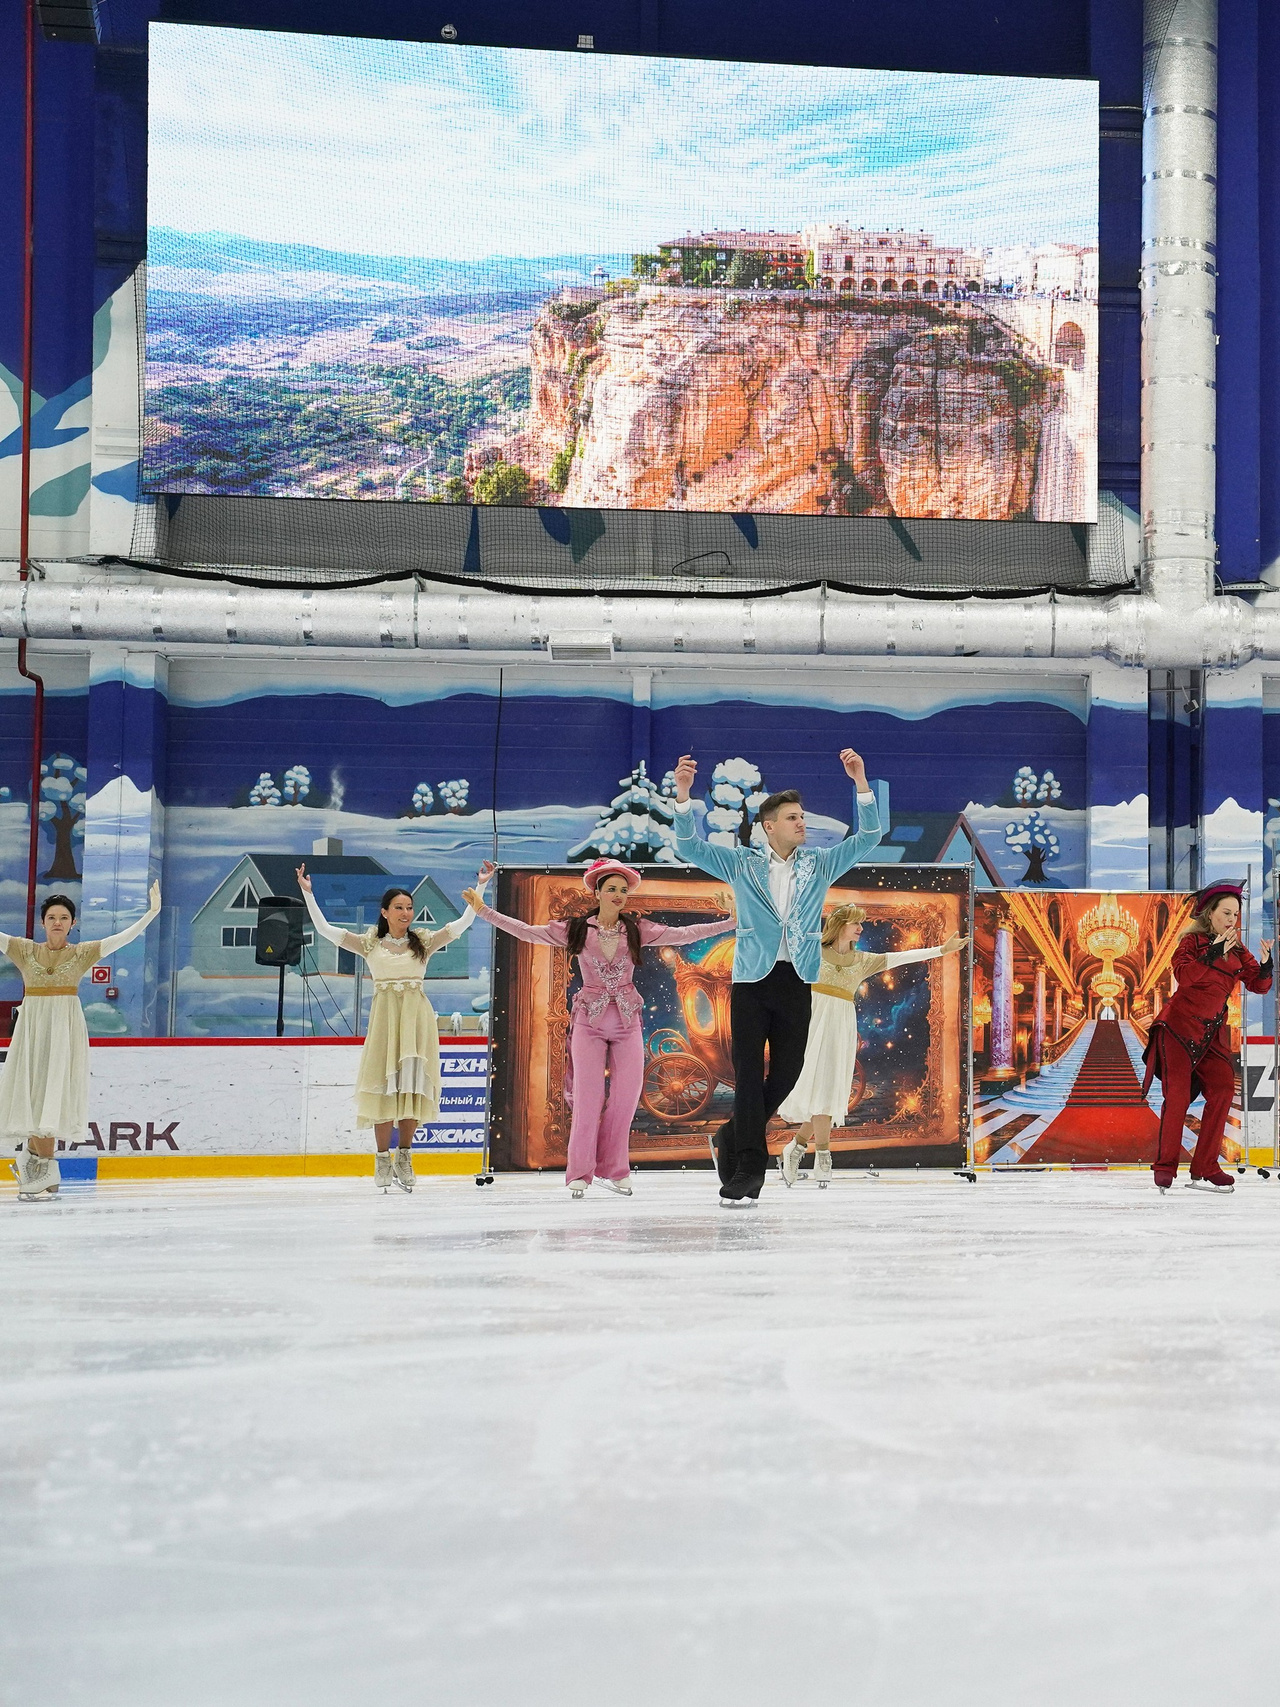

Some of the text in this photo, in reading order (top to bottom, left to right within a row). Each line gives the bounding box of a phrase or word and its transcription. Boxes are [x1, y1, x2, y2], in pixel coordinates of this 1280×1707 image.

[440, 1058, 487, 1072] ТЕХН
[57, 1122, 181, 1151] ARK
[427, 1128, 485, 1143] XCMG
